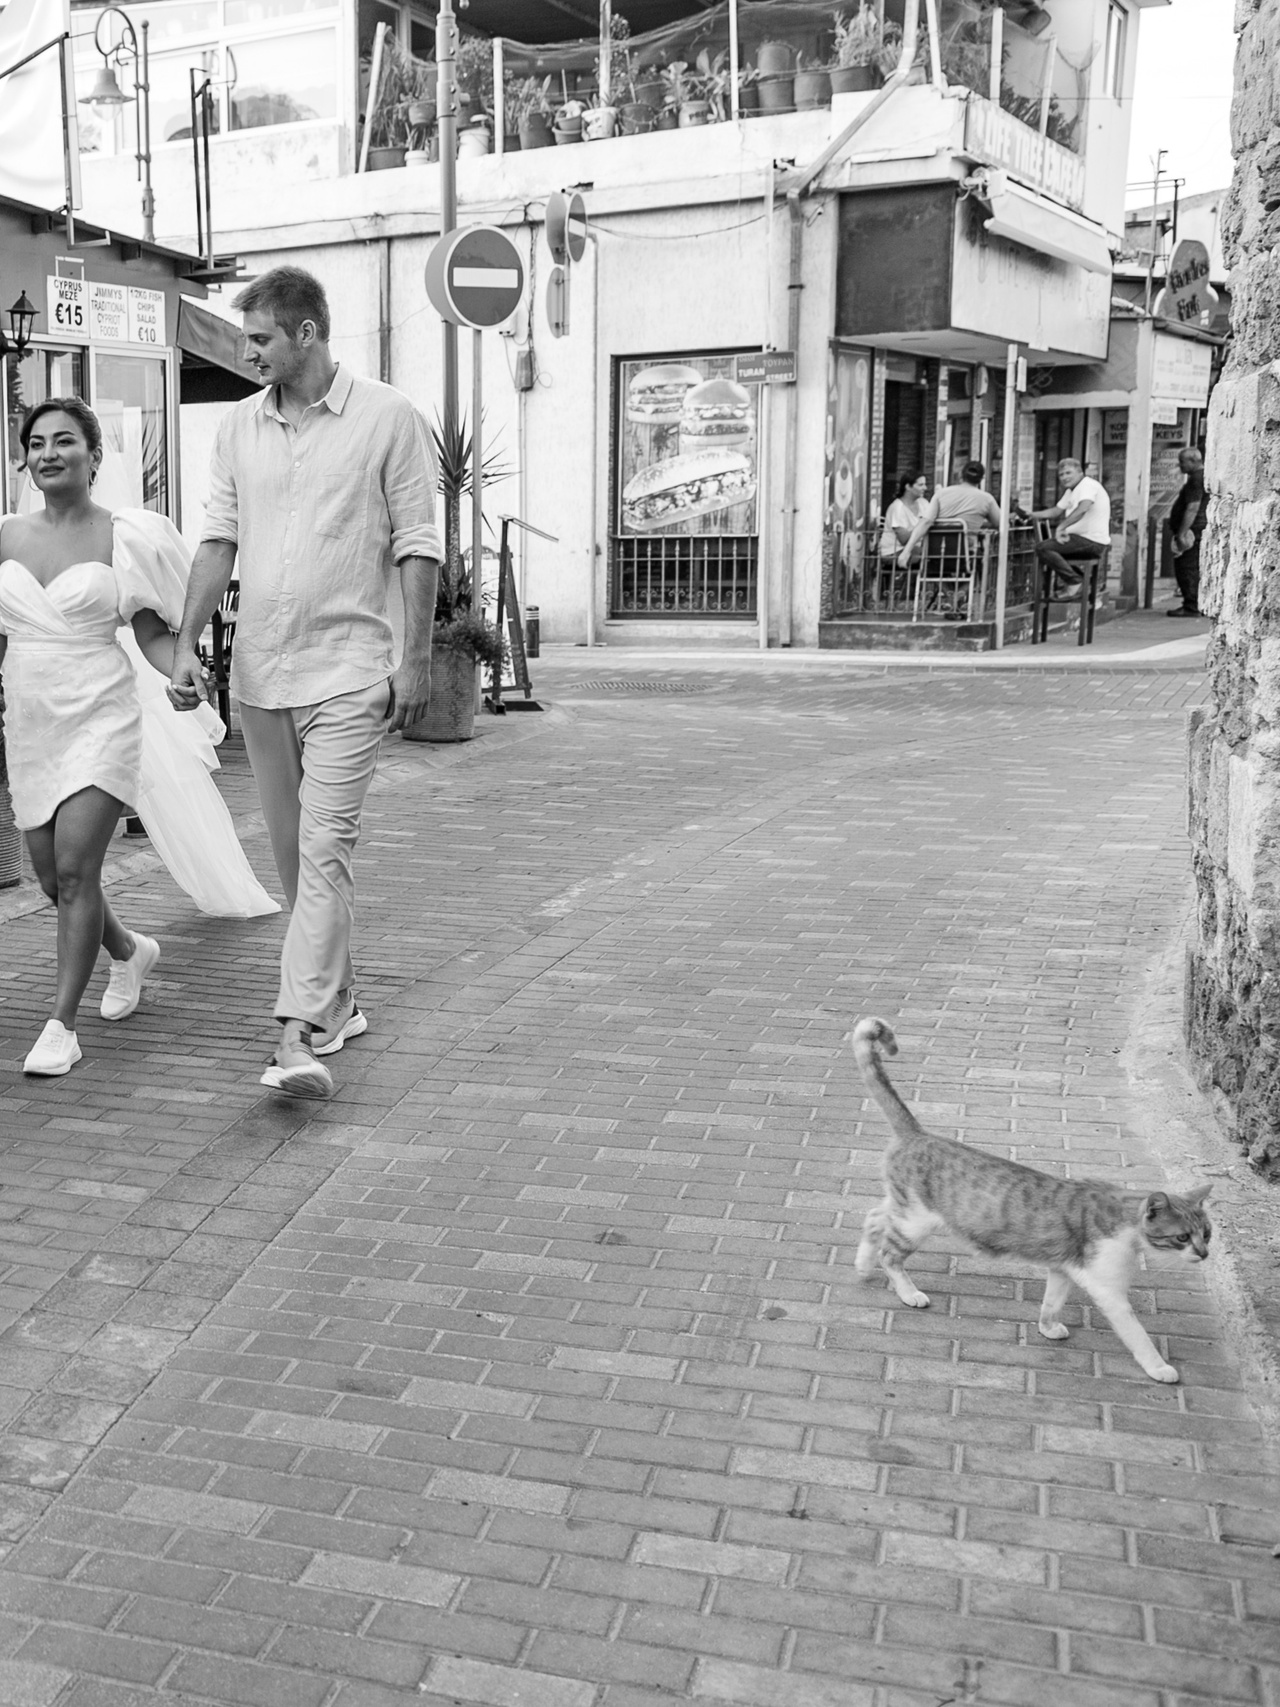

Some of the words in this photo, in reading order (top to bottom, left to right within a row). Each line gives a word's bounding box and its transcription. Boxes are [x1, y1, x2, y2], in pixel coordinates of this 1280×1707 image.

[53, 279, 83, 293] CYPRUS
[58, 290, 78, 301] MEZE
[94, 287, 122, 300] JIMMYS
[148, 291, 163, 302] FISH
[91, 300, 126, 314] TRADITIONAL
[136, 302, 156, 313] CHIPS
[55, 303, 83, 326] €15
[97, 312, 121, 325] CYPRIOT
[136, 314, 157, 324] SALAD
[100, 325, 119, 338] FOODS
[137, 327, 157, 343] €10
[738, 367, 766, 378] TURAN
[765, 373, 793, 382] STREET
[1156, 430, 1183, 439] KEYS
